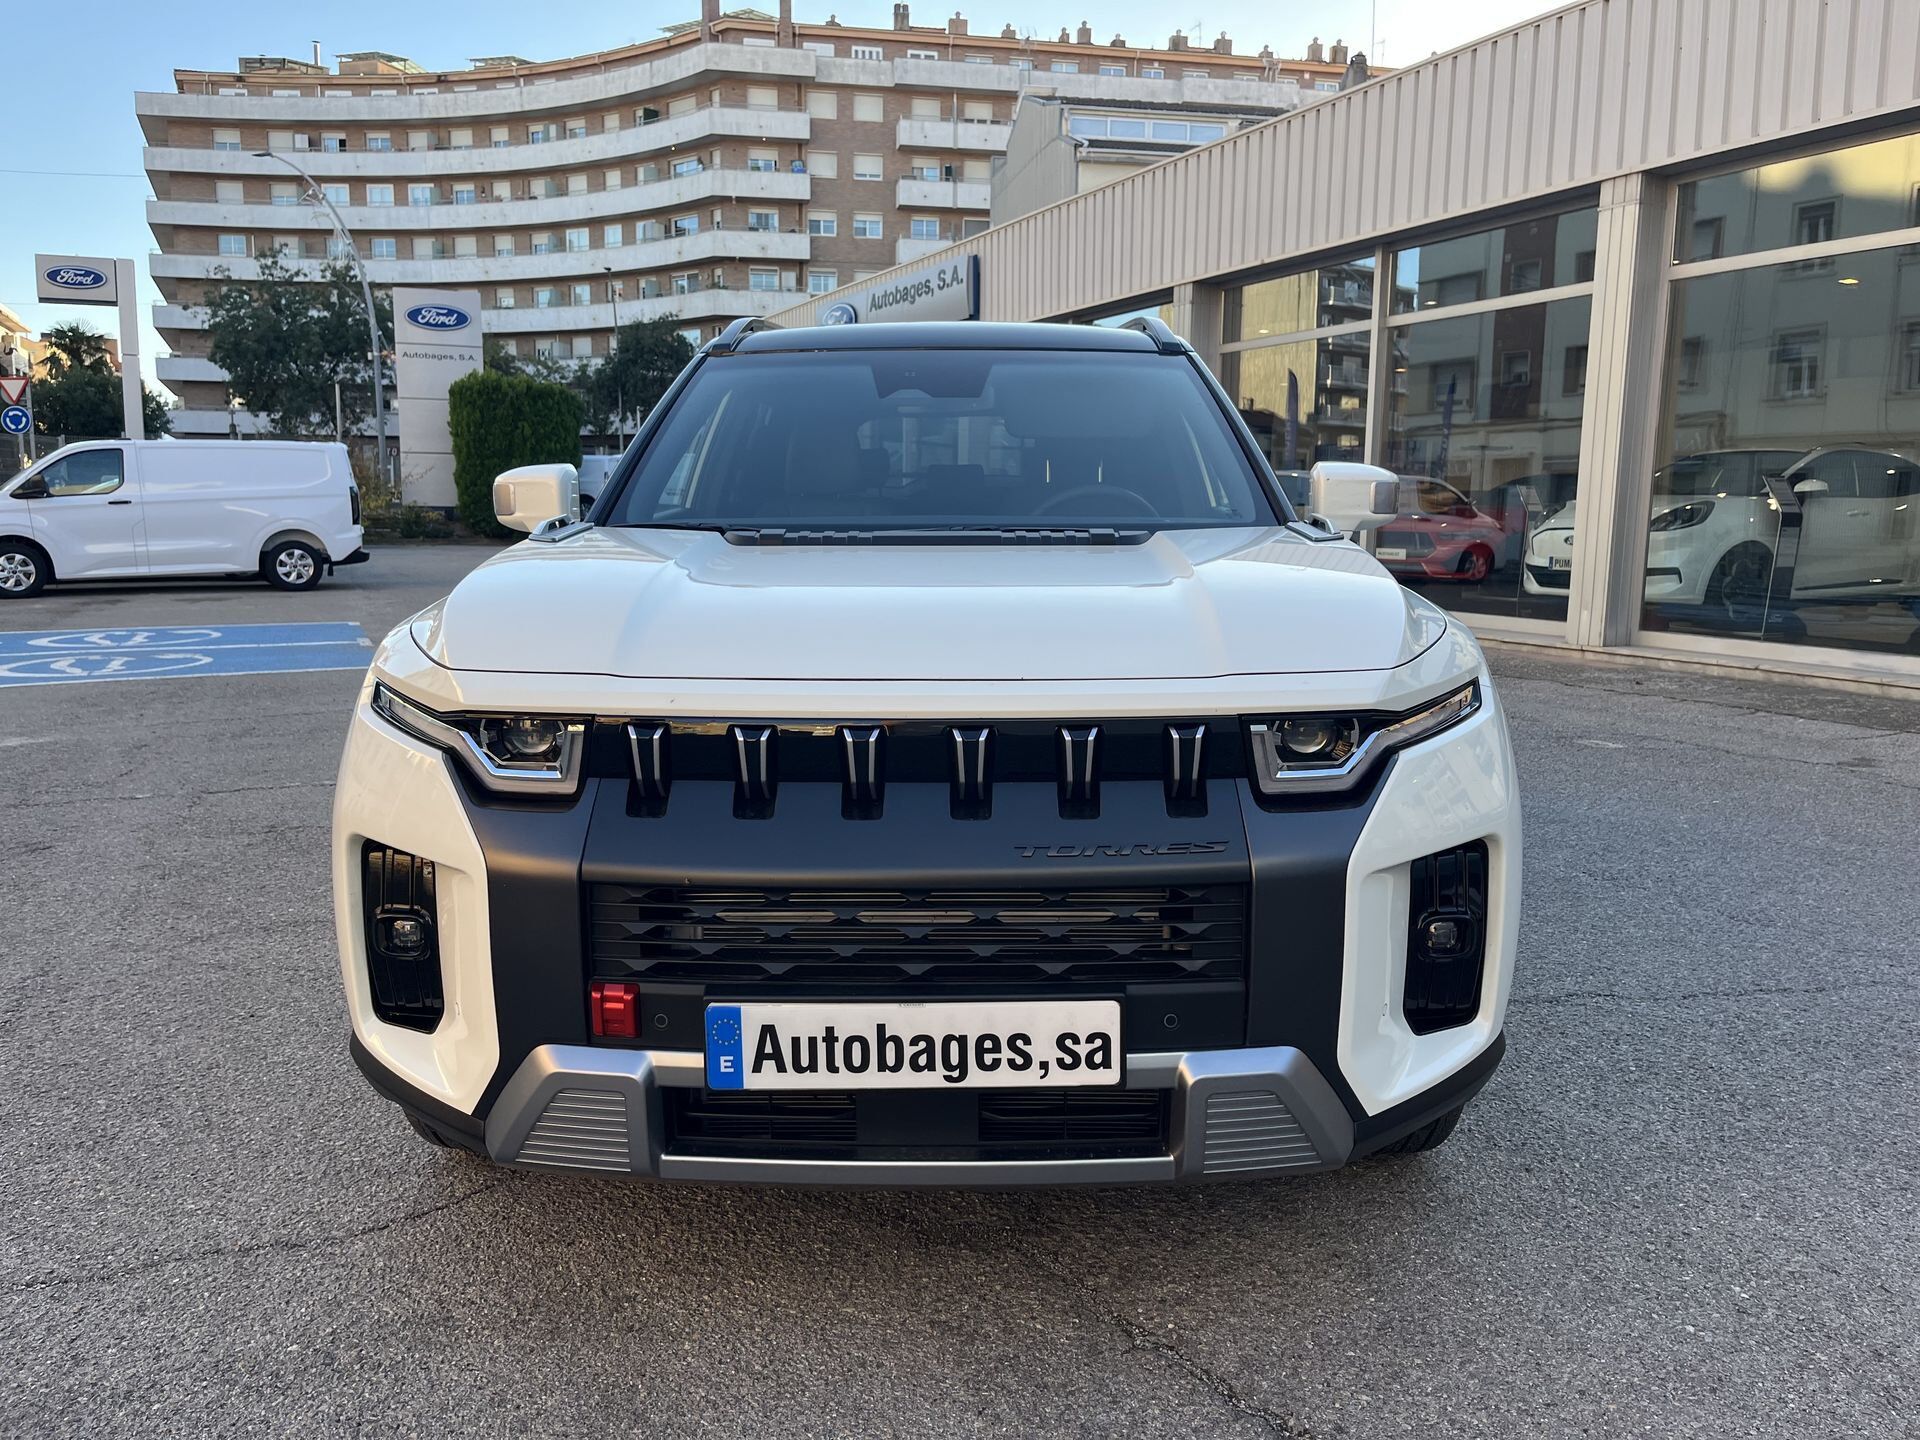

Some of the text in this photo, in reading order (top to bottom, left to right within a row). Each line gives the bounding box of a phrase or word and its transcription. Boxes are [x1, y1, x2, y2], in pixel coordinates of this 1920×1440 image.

[56, 268, 95, 285] Ford
[869, 265, 964, 312] Autobages, S.A.
[417, 307, 458, 326] Ford
[402, 351, 477, 362] Autobages, S.A.
[1013, 840, 1230, 858] TORRES
[751, 1023, 1113, 1084] Autobages,sa
[719, 1055, 734, 1073] E
